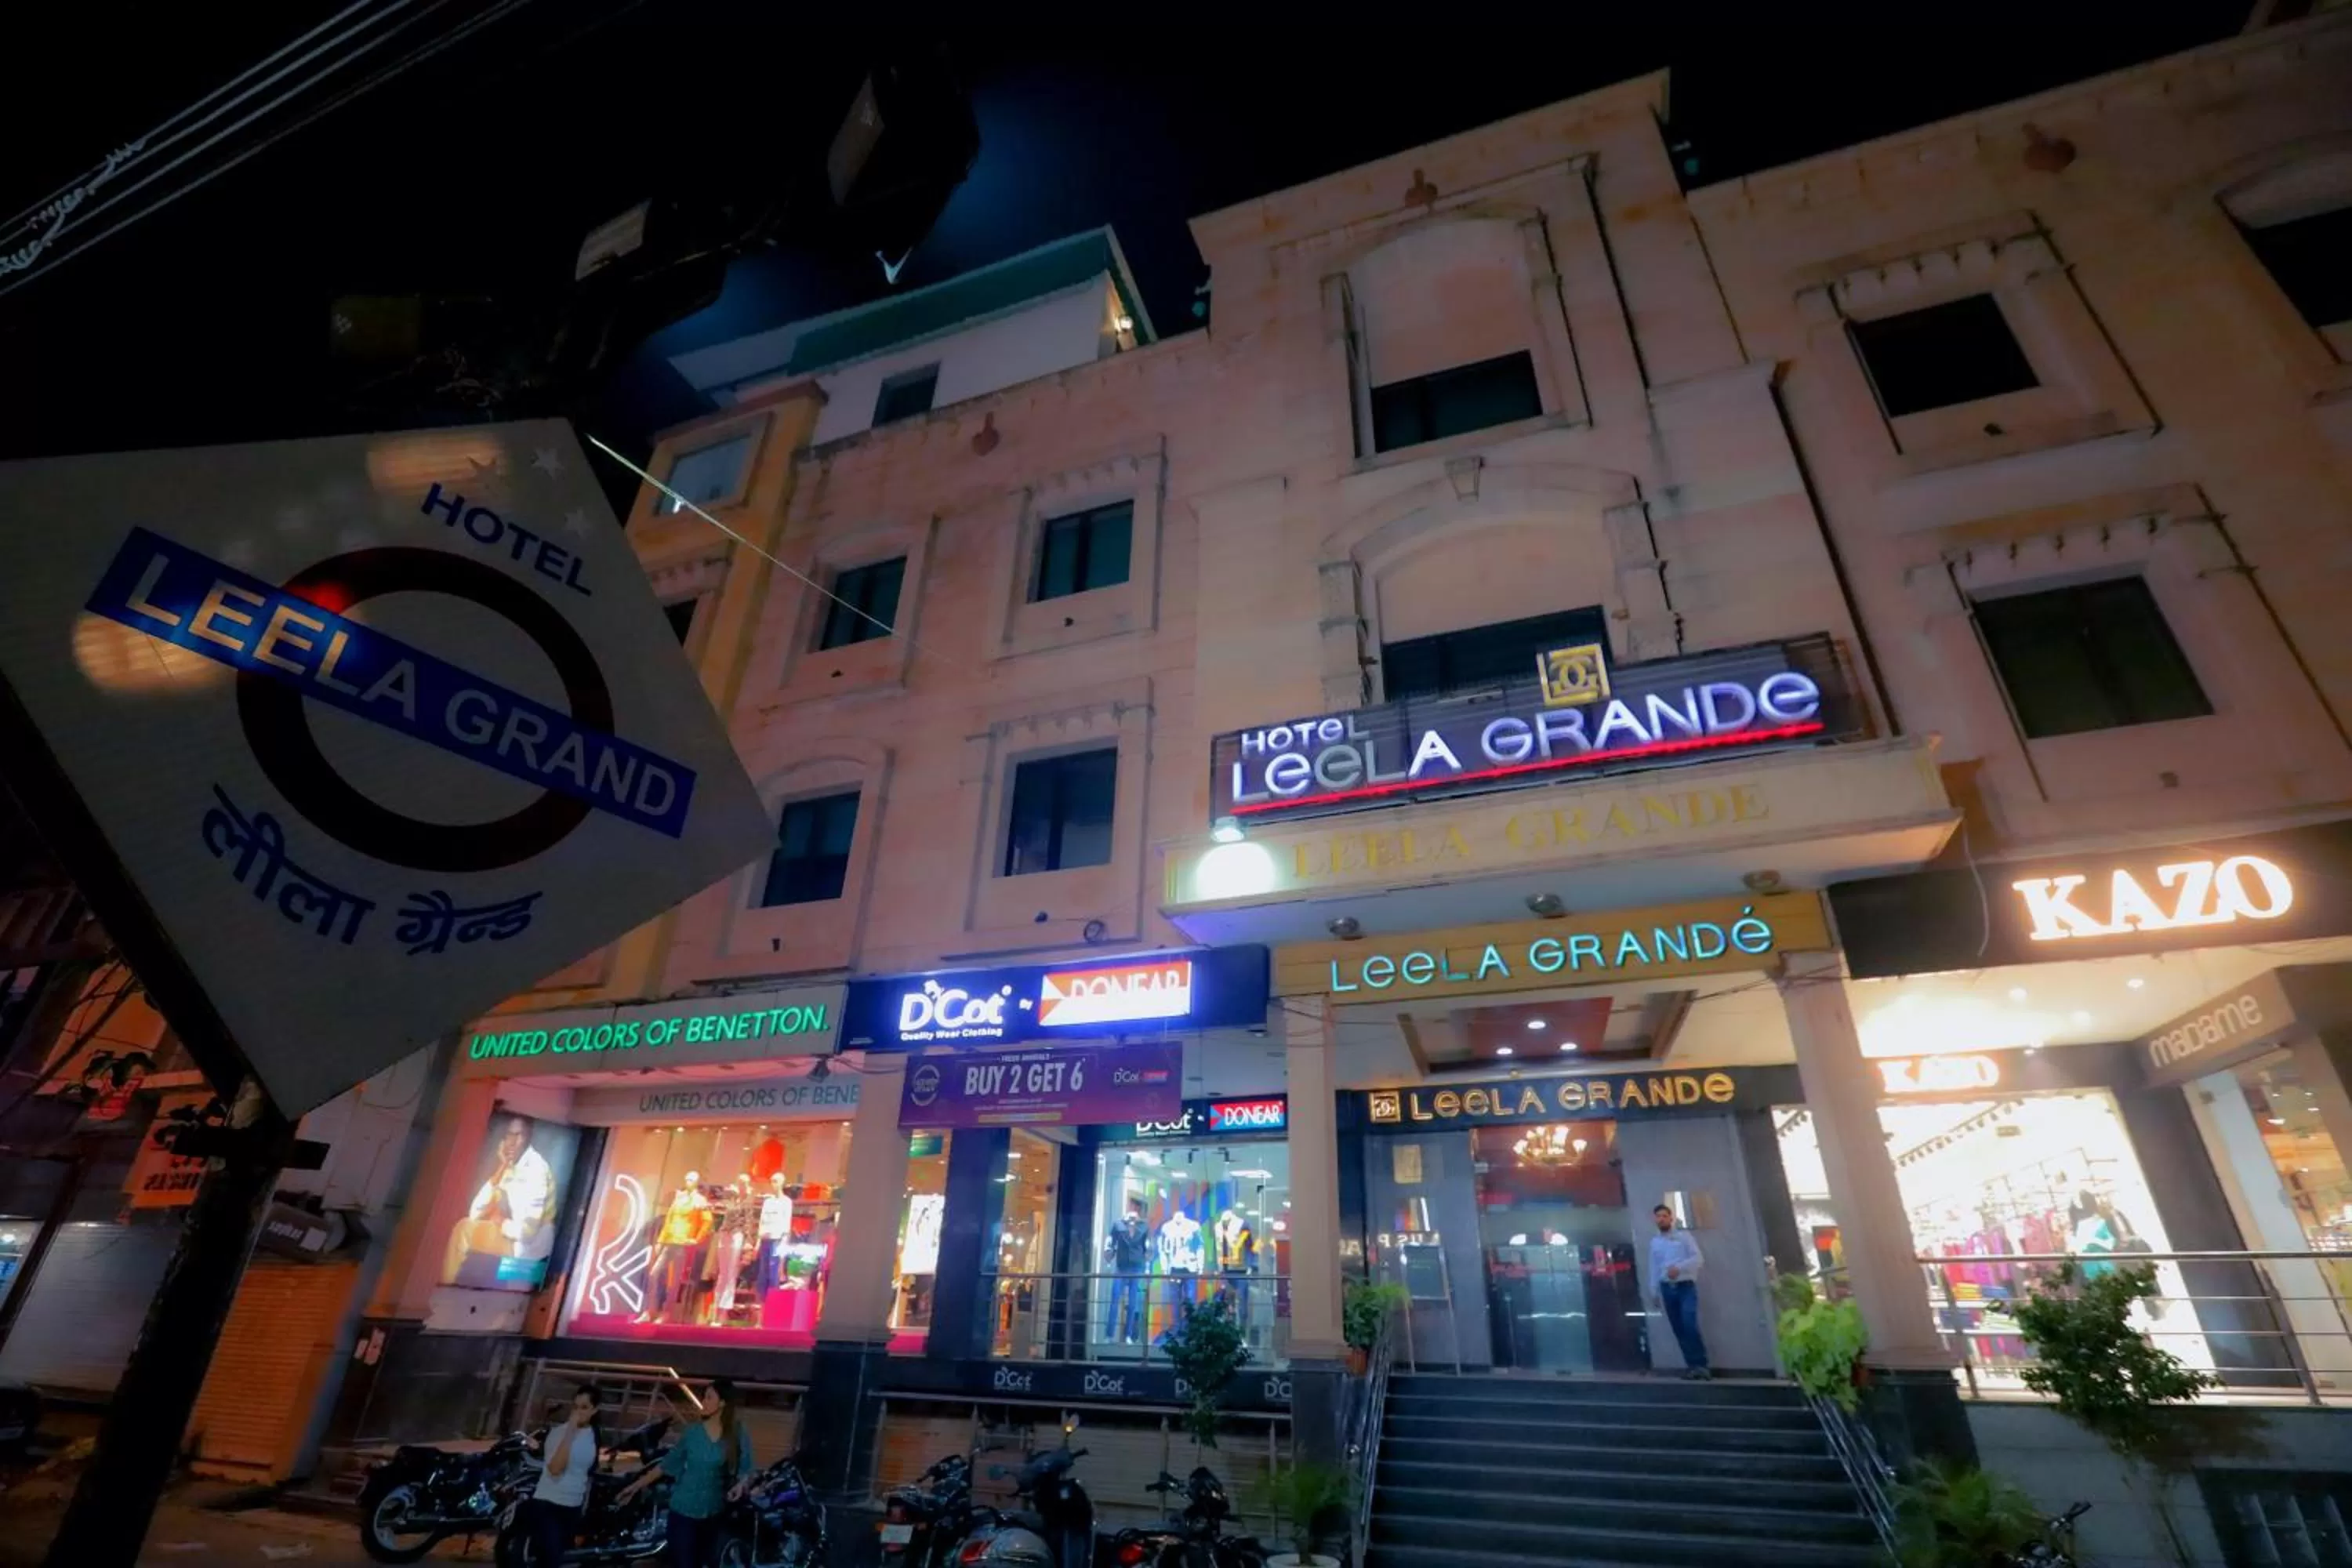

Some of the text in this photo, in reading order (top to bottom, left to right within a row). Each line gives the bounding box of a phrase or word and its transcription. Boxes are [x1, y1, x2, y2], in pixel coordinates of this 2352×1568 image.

[420, 482, 592, 597] HOTEL
[125, 554, 677, 818] LEELA GRAND
[1504, 786, 1770, 851] GRANDE
[201, 783, 377, 946] लीला
[2013, 855, 2294, 941] KAZO
[470, 1032, 547, 1060] UNITED
[550, 1022, 639, 1054] COLORS
[646, 1018, 684, 1046] OF
[936, 1029, 960, 1040] Wear
[962, 1028, 1004, 1038] Clothing
[639, 1090, 702, 1113] UNITED
[707, 1088, 775, 1109] COLORS
[783, 1086, 808, 1106] OF
[964, 1065, 1006, 1096] BUY
[1007, 1064, 1022, 1094] 2
[1027, 1062, 1067, 1093] GET
[1225, 1104, 1279, 1127] DONEAR
